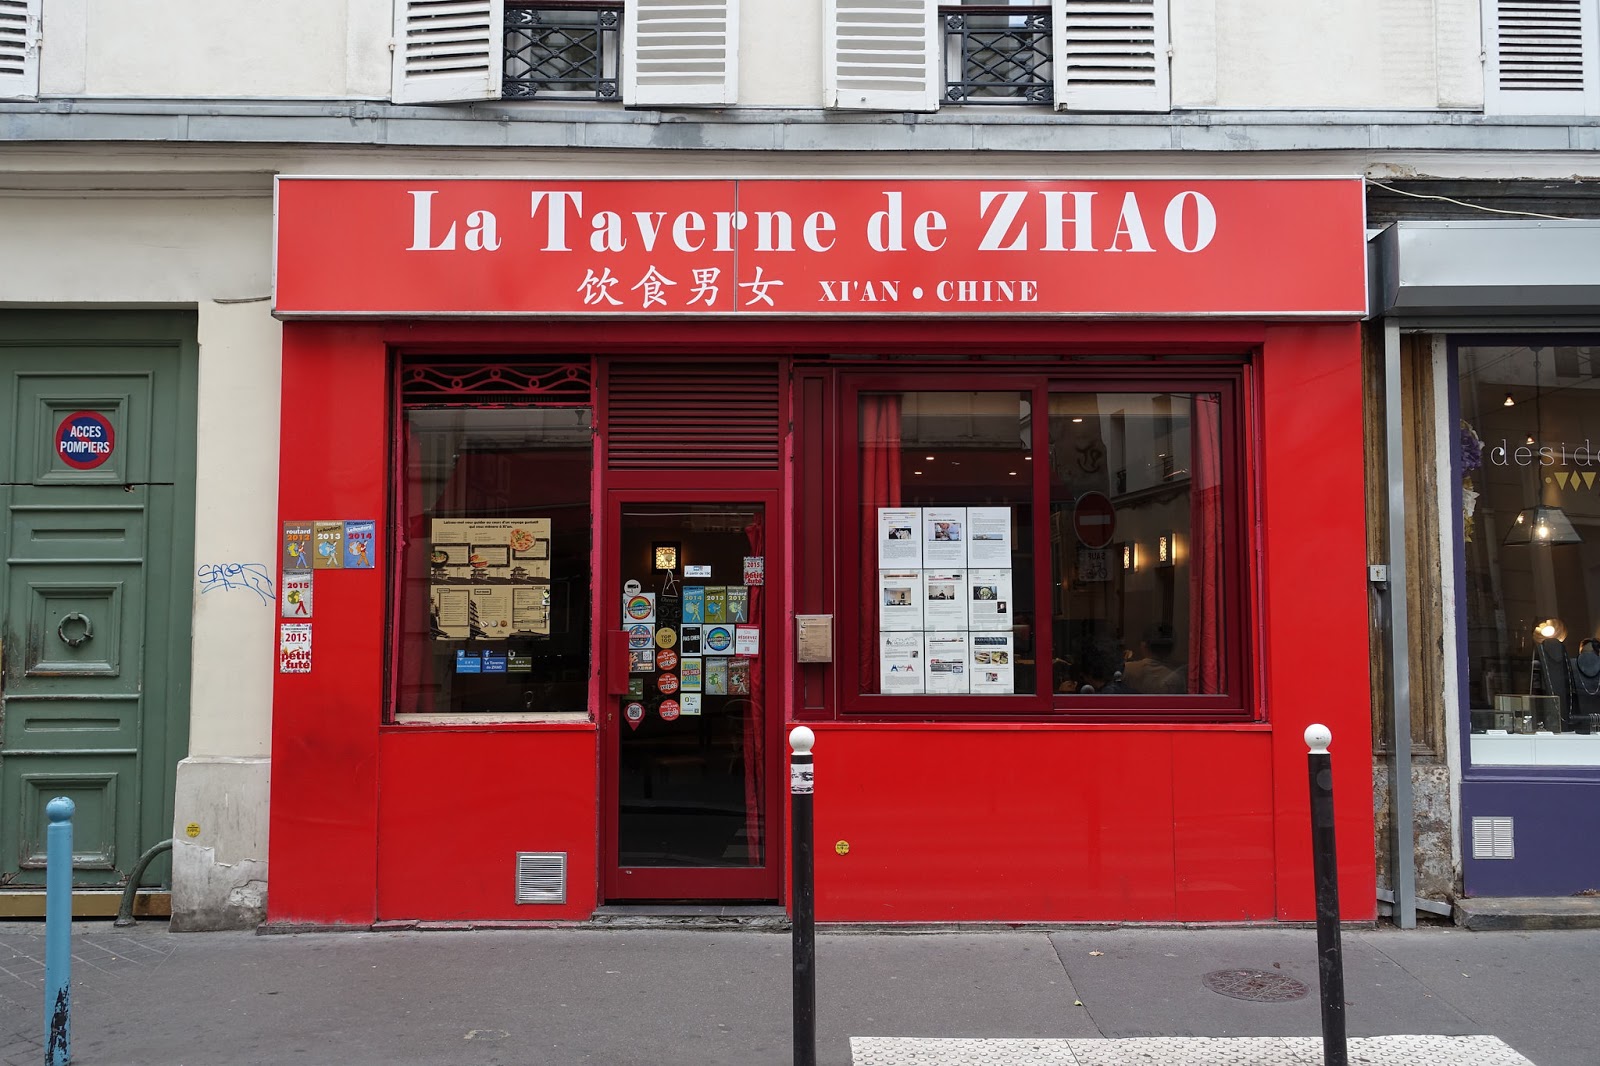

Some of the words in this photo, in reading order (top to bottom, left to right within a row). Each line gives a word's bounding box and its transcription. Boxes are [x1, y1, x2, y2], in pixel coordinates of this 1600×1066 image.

[405, 190, 502, 252] La
[530, 190, 837, 252] Taverne
[866, 190, 948, 252] de
[977, 190, 1218, 253] ZHAO
[576, 265, 784, 309] 饮食男女
[818, 280, 900, 303] XI'AN
[936, 280, 1039, 303] CHINE
[70, 425, 102, 438] ACCES
[60, 441, 110, 454] POMPIERS
[1490, 438, 1600, 466] desid
[285, 632, 307, 642] 2015
[282, 650, 311, 662] petit
[286, 659, 310, 669] futé
